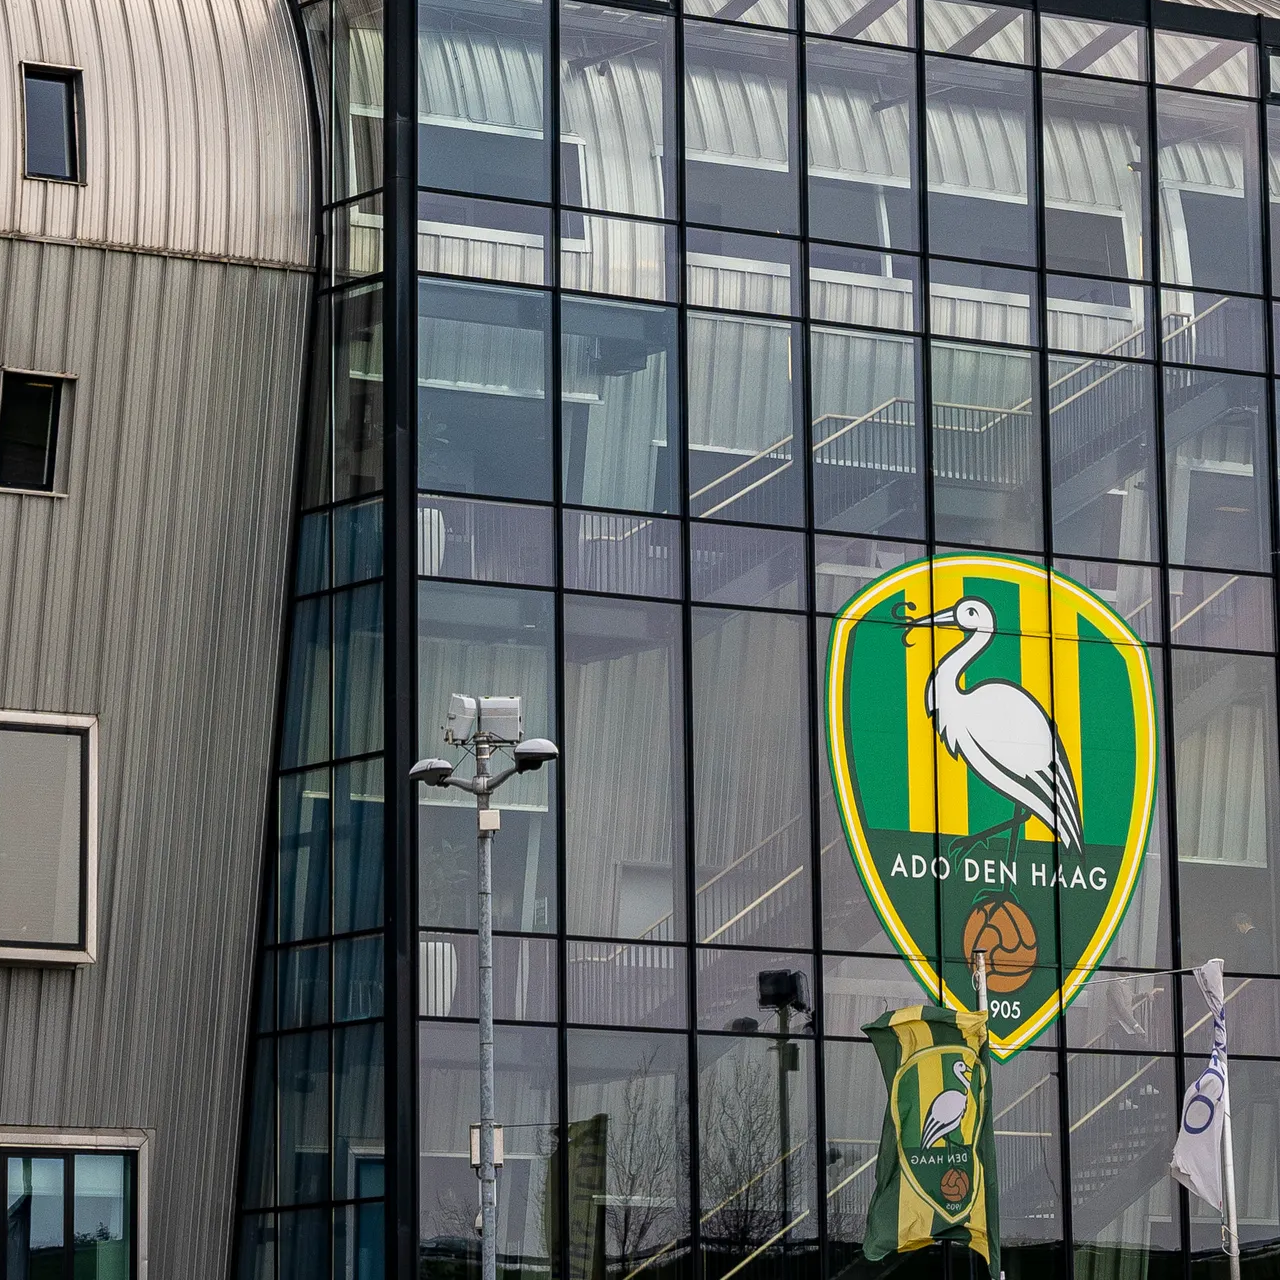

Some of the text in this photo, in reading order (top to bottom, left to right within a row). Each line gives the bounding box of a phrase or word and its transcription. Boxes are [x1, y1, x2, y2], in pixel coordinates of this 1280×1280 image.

[890, 853, 1108, 891] ADO DEN HAAG
[990, 999, 1021, 1019] 905
